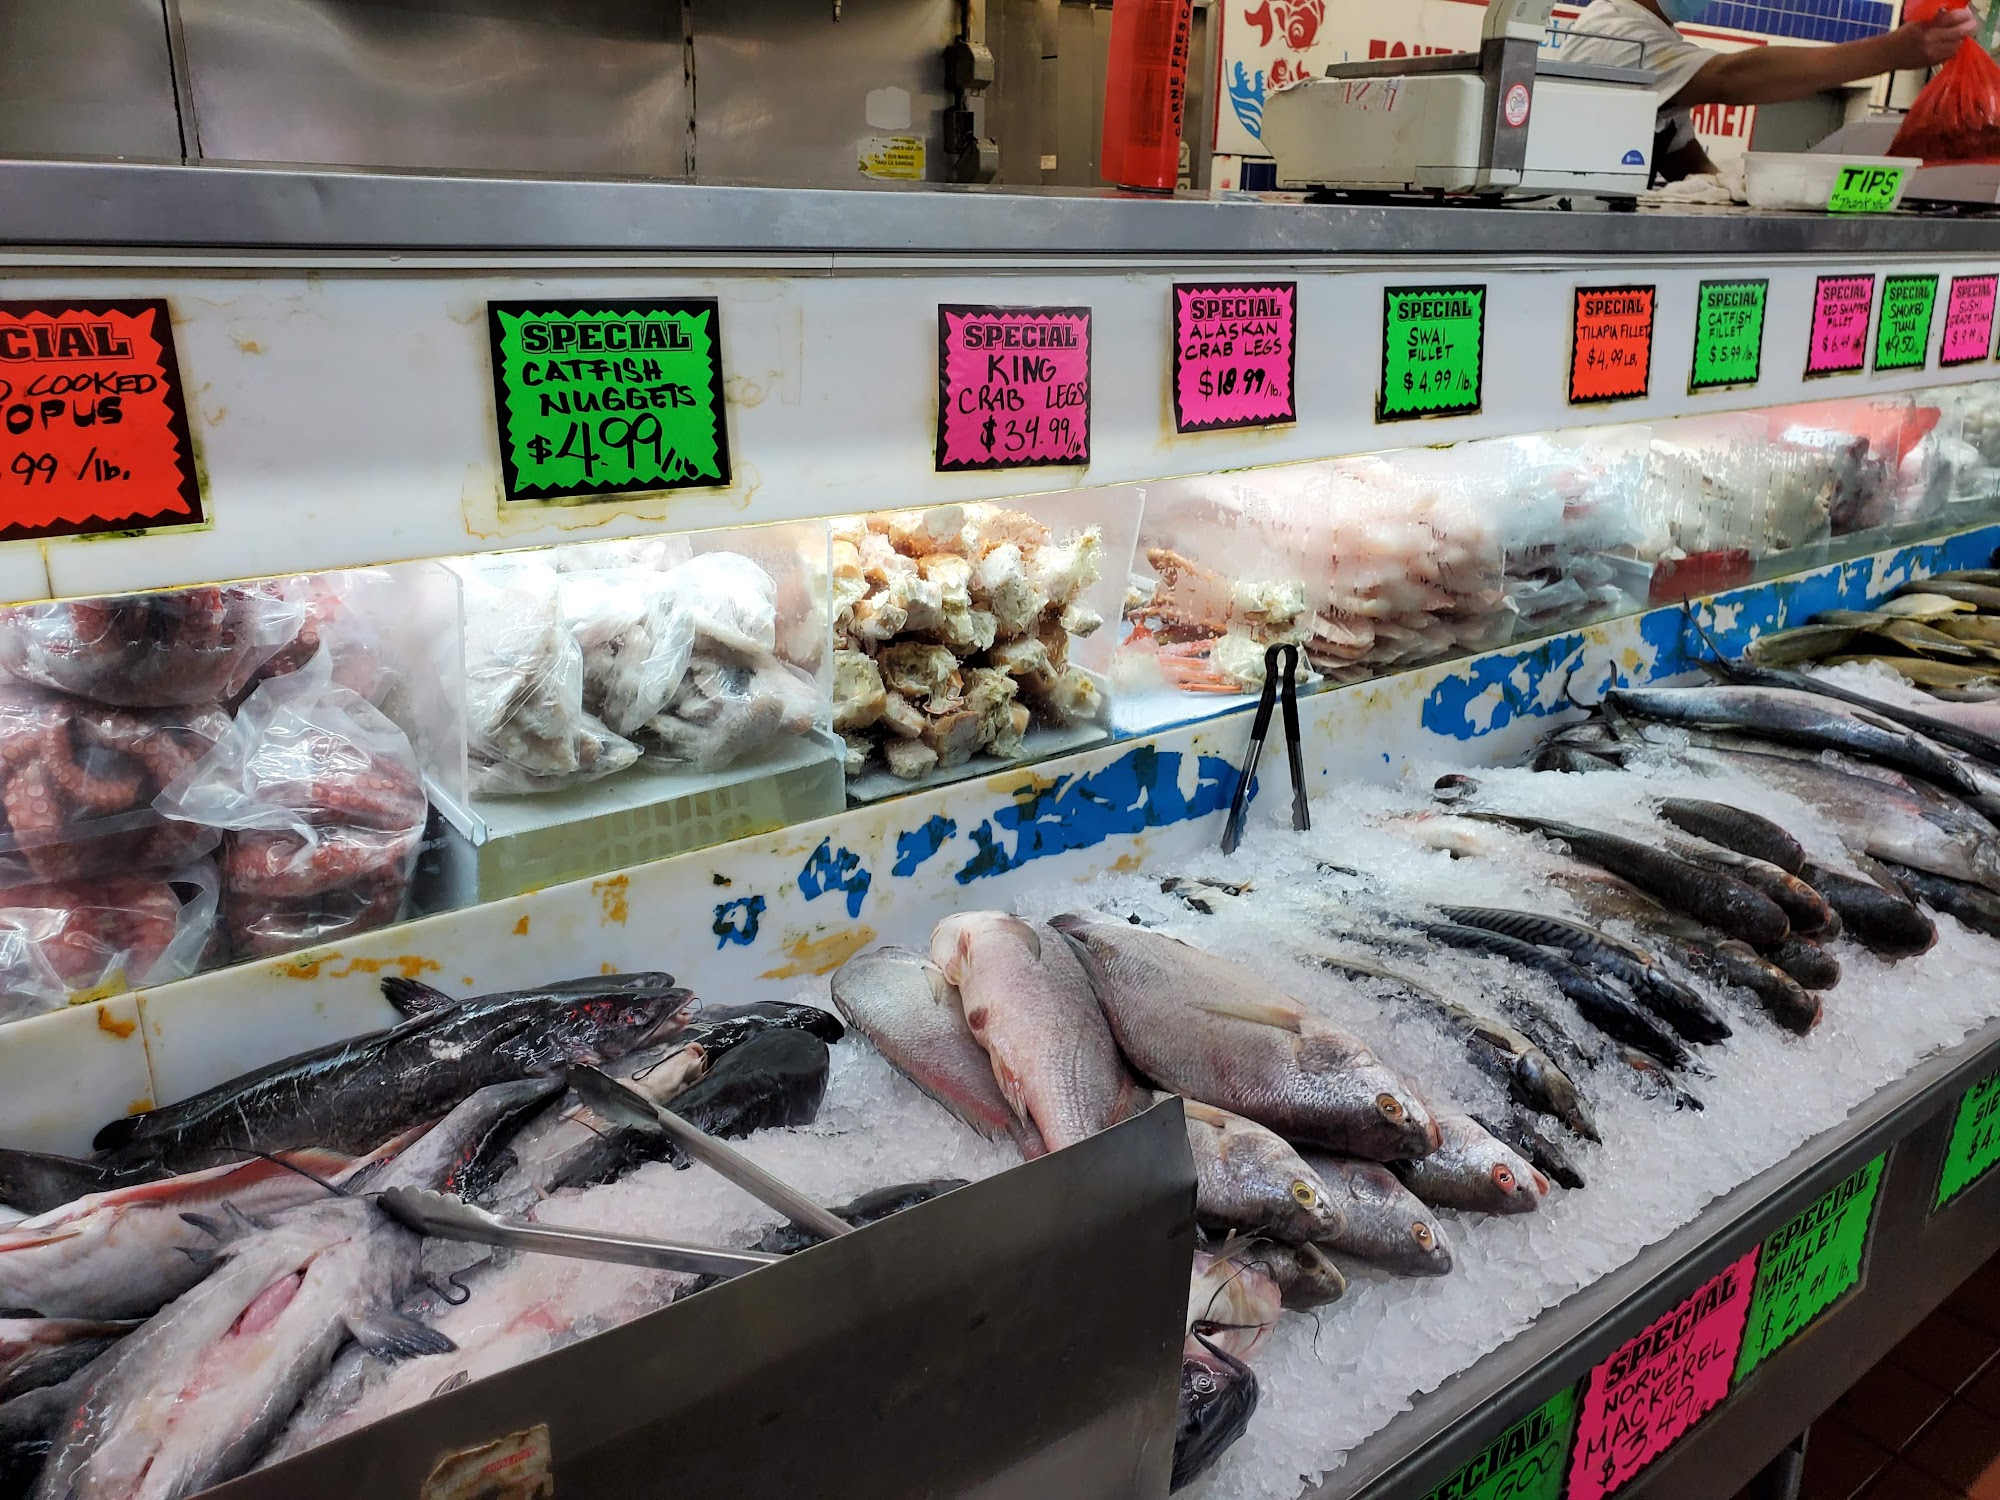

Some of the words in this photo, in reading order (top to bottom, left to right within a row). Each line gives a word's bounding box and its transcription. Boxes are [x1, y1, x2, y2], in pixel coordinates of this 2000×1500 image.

[1170, 76, 1181, 137] CARNE
[1843, 168, 1898, 195] TIPS
[1707, 290, 1758, 308] SPECIAL
[1823, 285, 1866, 301] SPECIAL
[1889, 285, 1930, 300] SPECIAL
[1956, 284, 1992, 299] SPECIAL
[1190, 295, 1282, 321] SPECIAL
[1397, 298, 1473, 322] SPECIAL
[1585, 297, 1645, 317] SPECIAL
[1708, 309, 1753, 326] CATFISH
[1823, 304, 1838, 317] RED
[1839, 301, 1870, 315] SNAPPER
[1887, 302, 1925, 319] SMOKED
[1959, 299, 1983, 314] SUSHI
[1974, 312, 1990, 324] TUNA
[1189, 320, 1278, 341] ALASKAN
[1620, 323, 1651, 339] FILLET
[1708, 325, 1745, 340] FILLET
[1826, 316, 1854, 330] FILLET
[1891, 318, 1916, 334] TUNA
[521, 320, 692, 353] SPECIAL
[963, 322, 1079, 350] SPECIAL
[1406, 326, 1447, 347] SWAI
[1184, 341, 1234, 360] CRAB
[1244, 337, 1282, 357] LEGS
[1408, 344, 1455, 363] FILLET
[522, 357, 664, 386] CATFISH
[987, 354, 1057, 385] KING
[27, 371, 158, 396] COOKED
[538, 382, 697, 417] NUGGETS
[958, 384, 1025, 415] CRAB
[1045, 382, 1086, 409] LEGS
[1764, 1162, 1872, 1268] SPECIAL
[1760, 1206, 1849, 1300] MULLET
[1762, 1262, 1808, 1312] FISH
[1602, 1270, 1740, 1393] SPECIAL
[1603, 1331, 1695, 1420] NORWAY
[1583, 1338, 1726, 1471] MACKEREL
